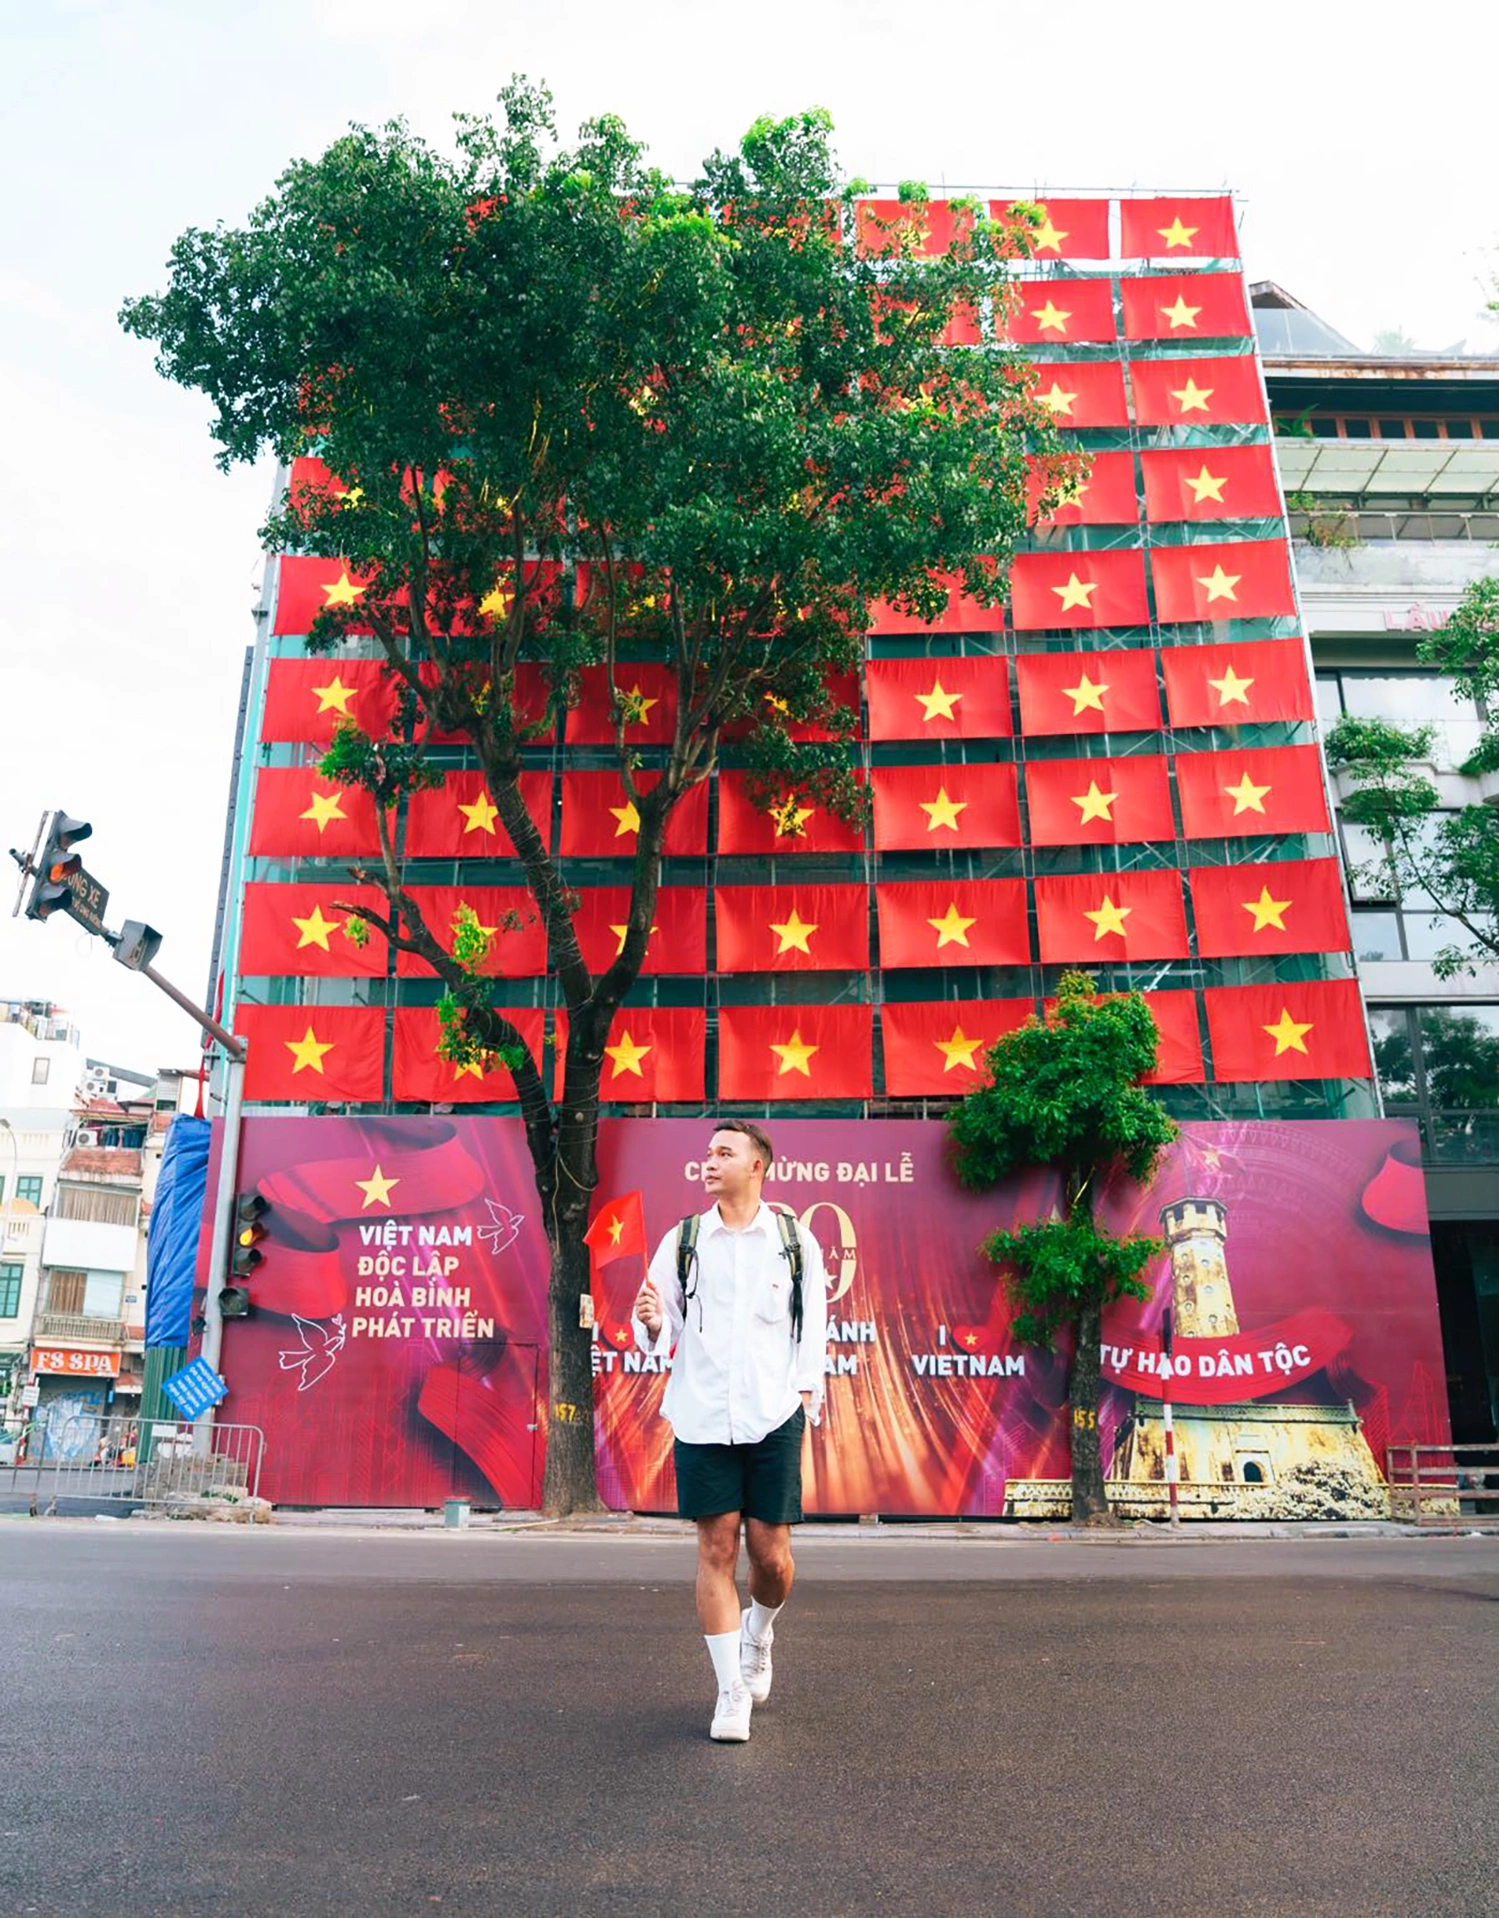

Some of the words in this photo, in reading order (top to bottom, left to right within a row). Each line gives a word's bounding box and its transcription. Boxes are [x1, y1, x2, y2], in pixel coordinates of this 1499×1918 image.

[836, 1162, 877, 1187] ĐẠI
[885, 1152, 914, 1182] LỄ
[359, 1219, 413, 1250] VIỆT
[418, 1225, 472, 1246] NAM
[358, 1250, 406, 1281] ĐỘC
[412, 1250, 459, 1281] LẬP
[355, 1281, 405, 1307] HOÀ
[411, 1281, 471, 1307] BÌNH
[352, 1311, 416, 1338] PHÁT
[421, 1309, 494, 1338] TRIỂN
[826, 1314, 876, 1342] ÁNH
[939, 1324, 946, 1346] I
[825, 1354, 857, 1375] AM
[911, 1354, 1025, 1376] VIETNAM
[1198, 1349, 1254, 1377] DÂN
[1257, 1342, 1311, 1375] TỘC
